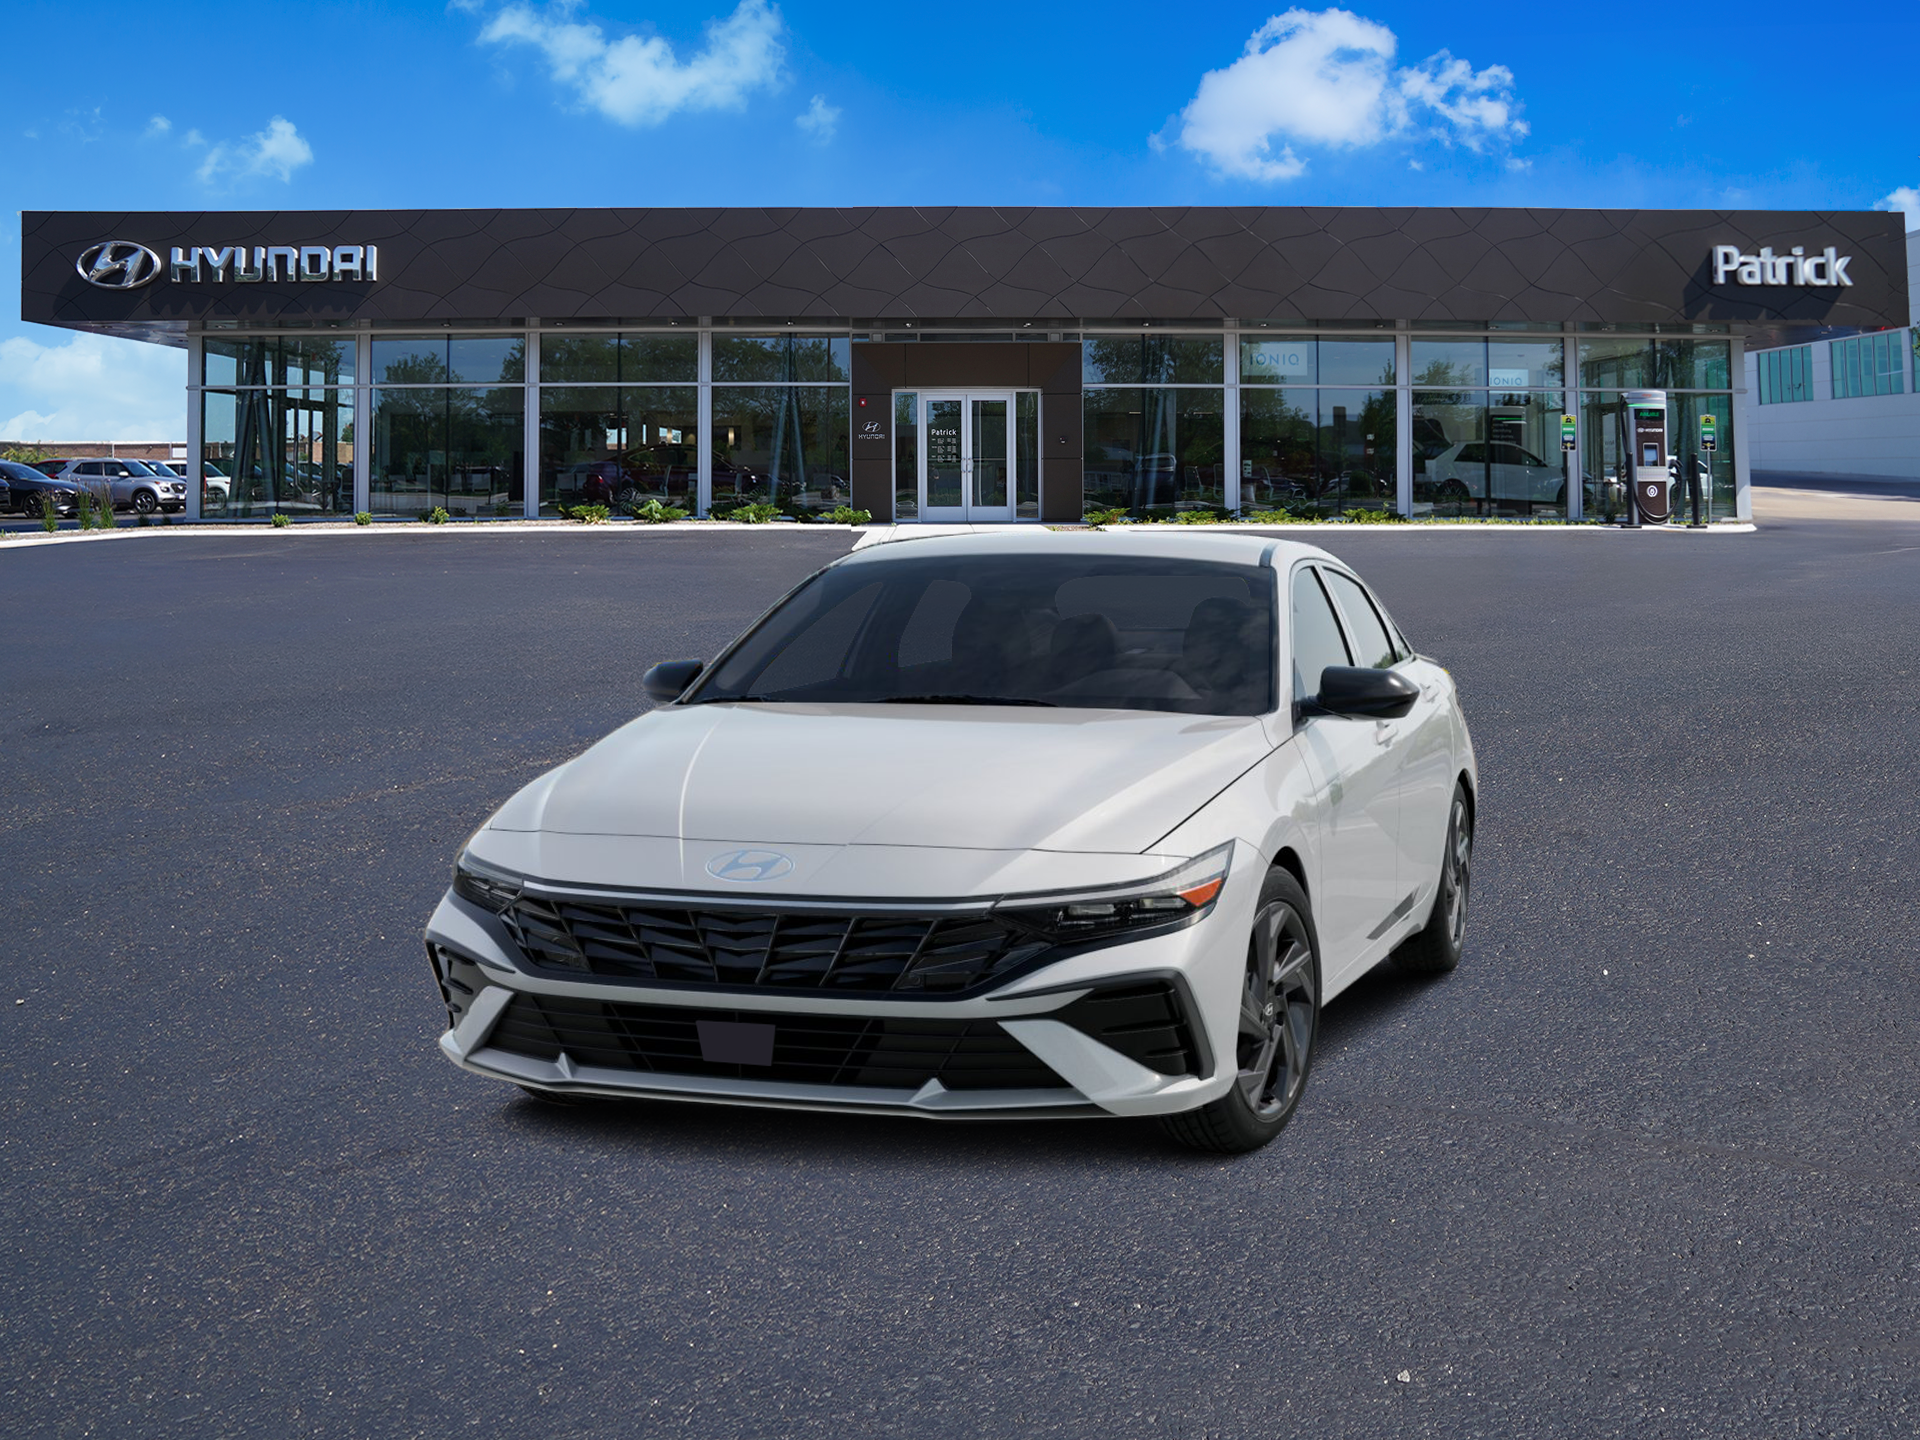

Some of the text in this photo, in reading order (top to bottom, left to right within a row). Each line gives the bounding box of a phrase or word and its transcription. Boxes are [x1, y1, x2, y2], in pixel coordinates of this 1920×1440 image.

[170, 245, 378, 283] HYUNDAI
[1712, 245, 1854, 287] Patrick
[1250, 353, 1300, 366] IONIQ
[1490, 377, 1523, 386] IONIQ
[931, 428, 957, 436] Patrick
